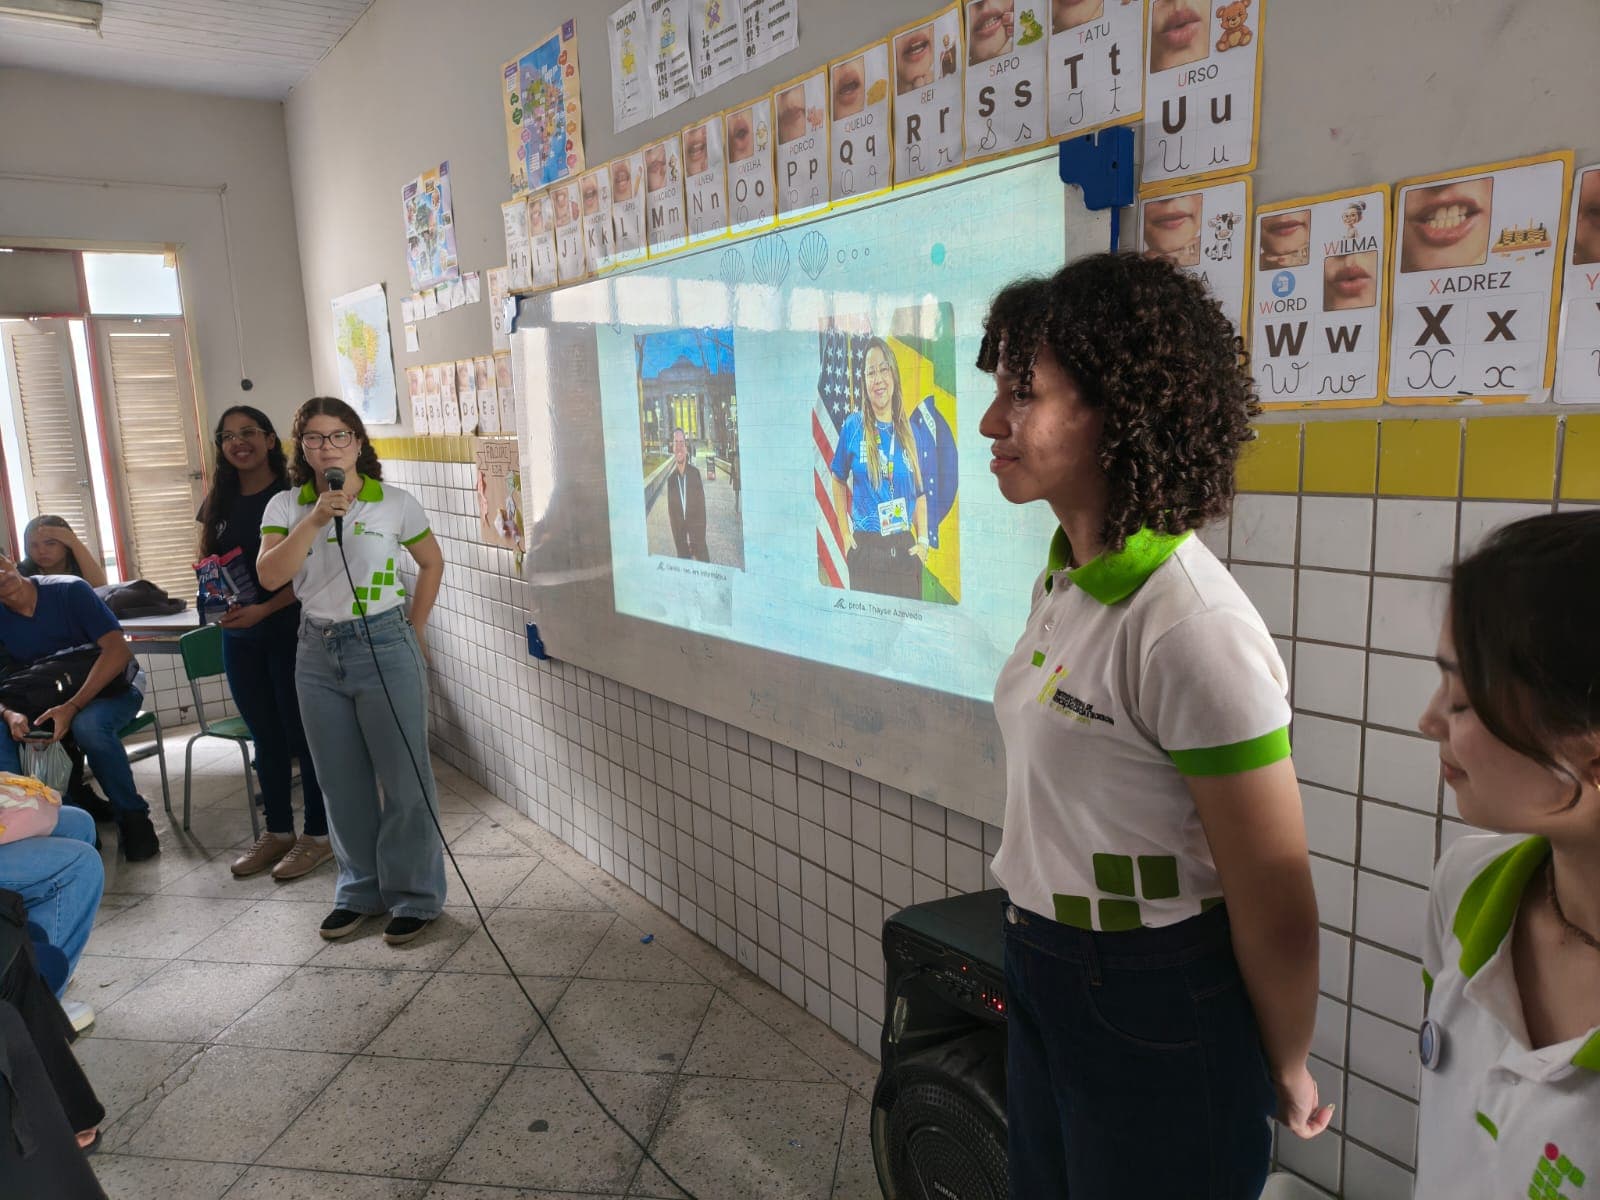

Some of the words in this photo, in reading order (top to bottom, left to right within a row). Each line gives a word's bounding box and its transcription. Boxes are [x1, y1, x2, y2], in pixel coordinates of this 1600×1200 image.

[1078, 22, 1110, 45] TATU
[989, 56, 1020, 78] SAPO
[1064, 53, 1084, 90] T
[1109, 42, 1121, 76] t
[1178, 64, 1219, 87] URSO
[920, 88, 935, 105] REI
[978, 86, 995, 118] S
[844, 113, 874, 133] QUEIJO
[1162, 95, 1187, 135] U
[1210, 93, 1232, 124] u
[906, 114, 921, 145] R
[939, 107, 950, 134] r
[789, 137, 815, 156] PORCO
[840, 139, 854, 166] Q
[866, 134, 876, 157] q
[1207, 145, 1230, 166] u
[738, 158, 762, 175] OVELHA
[787, 160, 798, 188] P
[809, 158, 818, 181] p
[735, 178, 748, 203] O
[755, 180, 765, 197] o
[692, 190, 704, 215] N
[710, 191, 720, 210] n
[620, 217, 628, 237] L
[651, 205, 665, 229] M
[668, 206, 680, 225] m
[561, 239, 568, 258] J
[588, 228, 596, 249] K
[601, 226, 609, 246] k
[1323, 235, 1379, 256] WILMA
[510, 252, 518, 270] H
[521, 251, 528, 267] h
[1428, 271, 1512, 295] XADREZ
[1259, 297, 1308, 315] WORD
[494, 316, 501, 330] G
[1414, 303, 1454, 347] X
[1483, 309, 1518, 342] x
[1264, 320, 1309, 358] W
[1325, 324, 1362, 354] w
[444, 402, 450, 417] C
[462, 402, 468, 416] D
[482, 400, 487, 416] E
